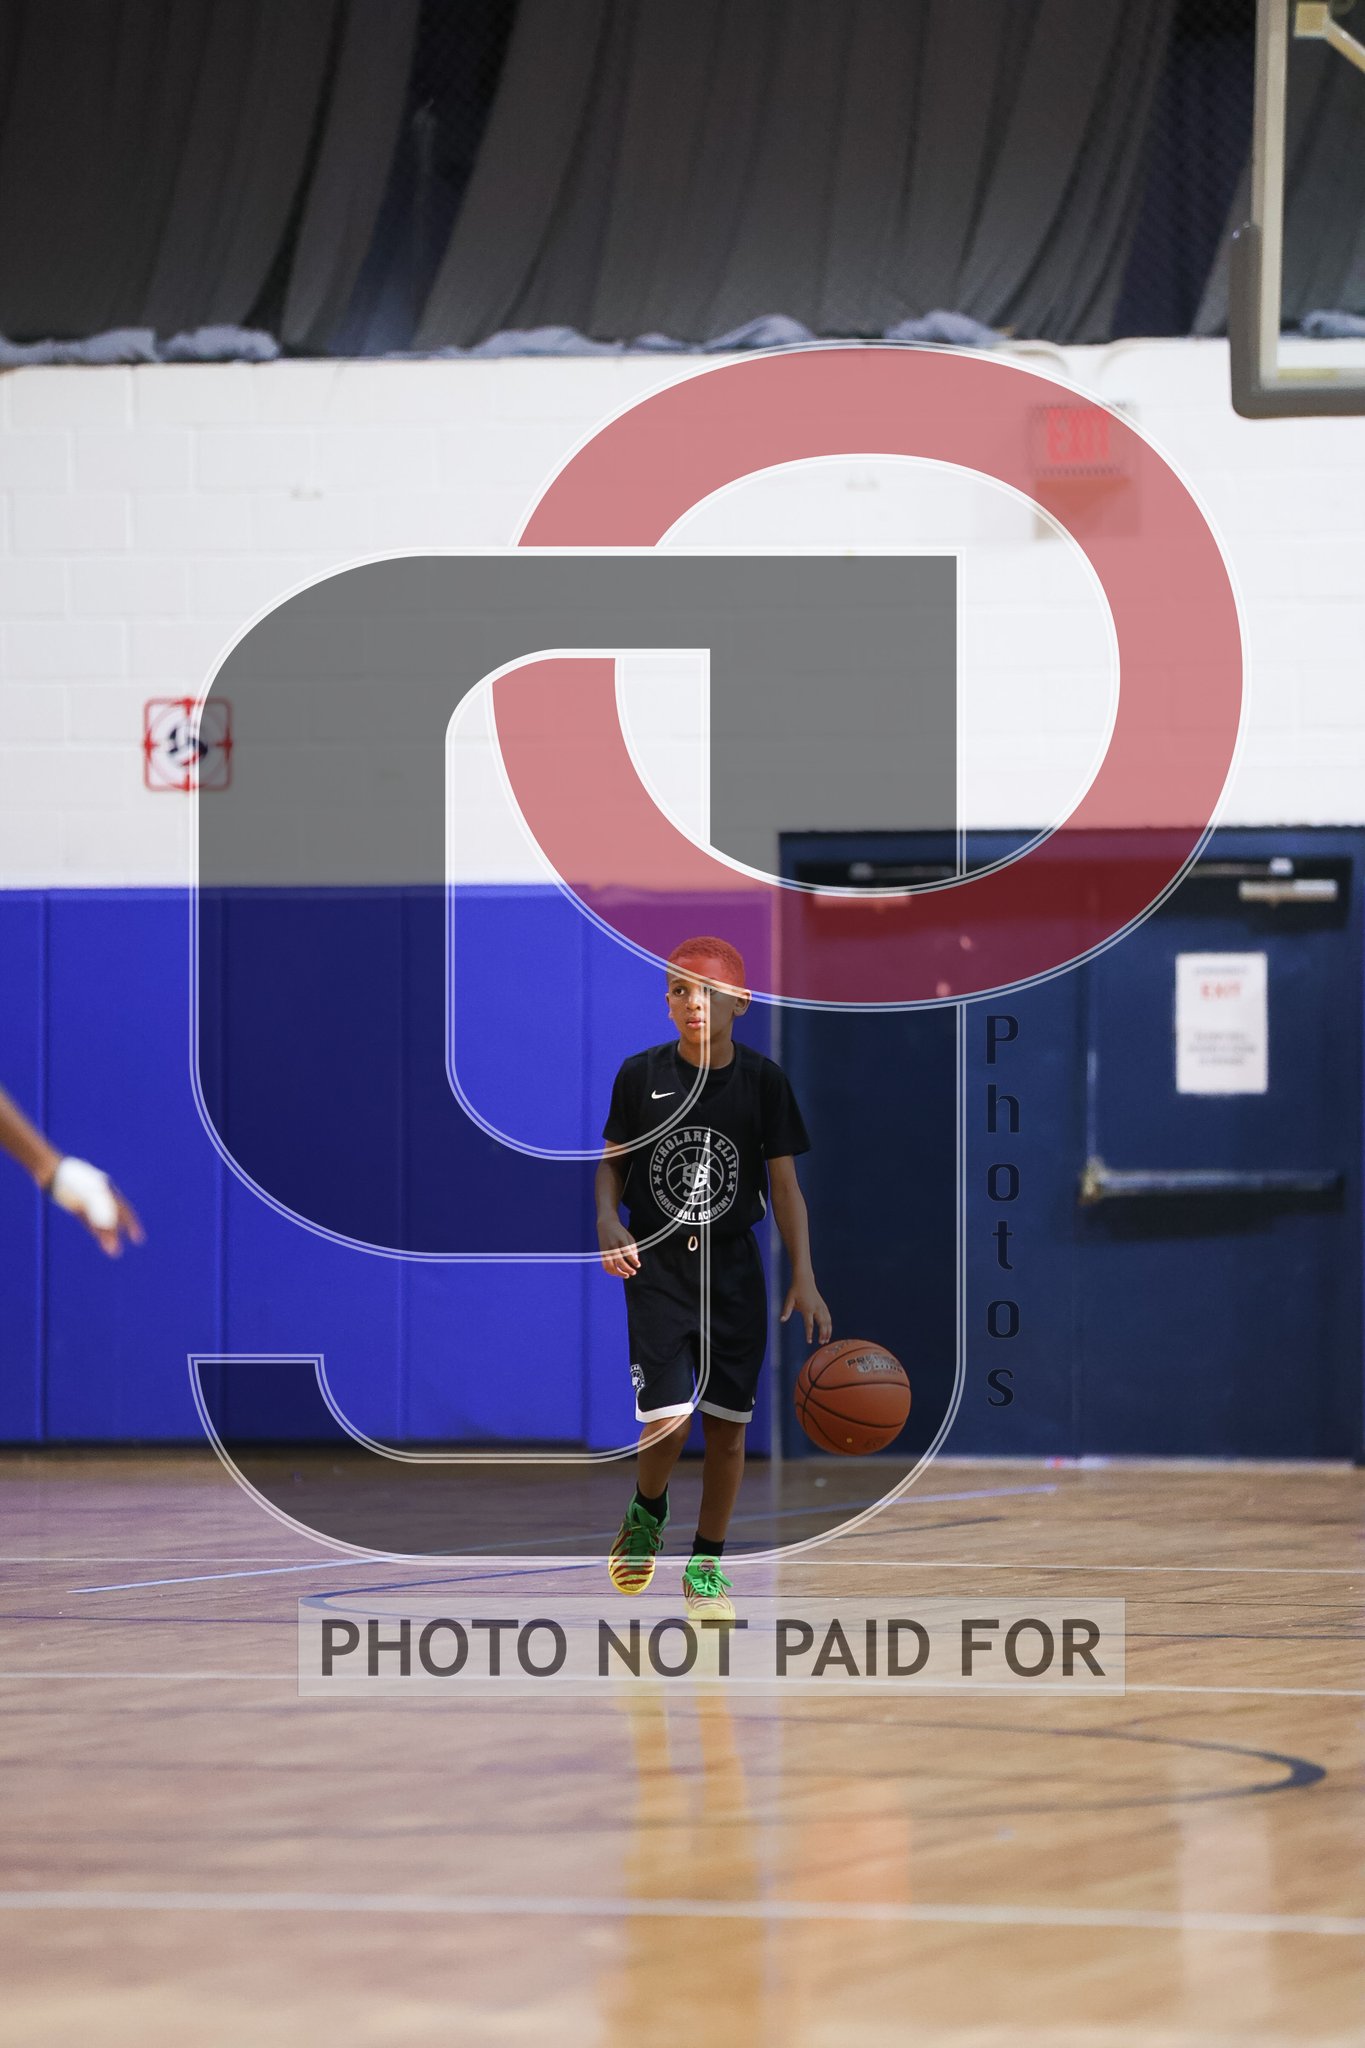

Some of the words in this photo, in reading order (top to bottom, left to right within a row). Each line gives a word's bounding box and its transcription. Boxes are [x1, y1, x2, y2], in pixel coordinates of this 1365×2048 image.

[653, 1131, 710, 1172] SCHOLARS
[714, 1138, 737, 1179] ELITE
[655, 1189, 696, 1221] BASKETBALL
[698, 1195, 731, 1221] ACADEMY
